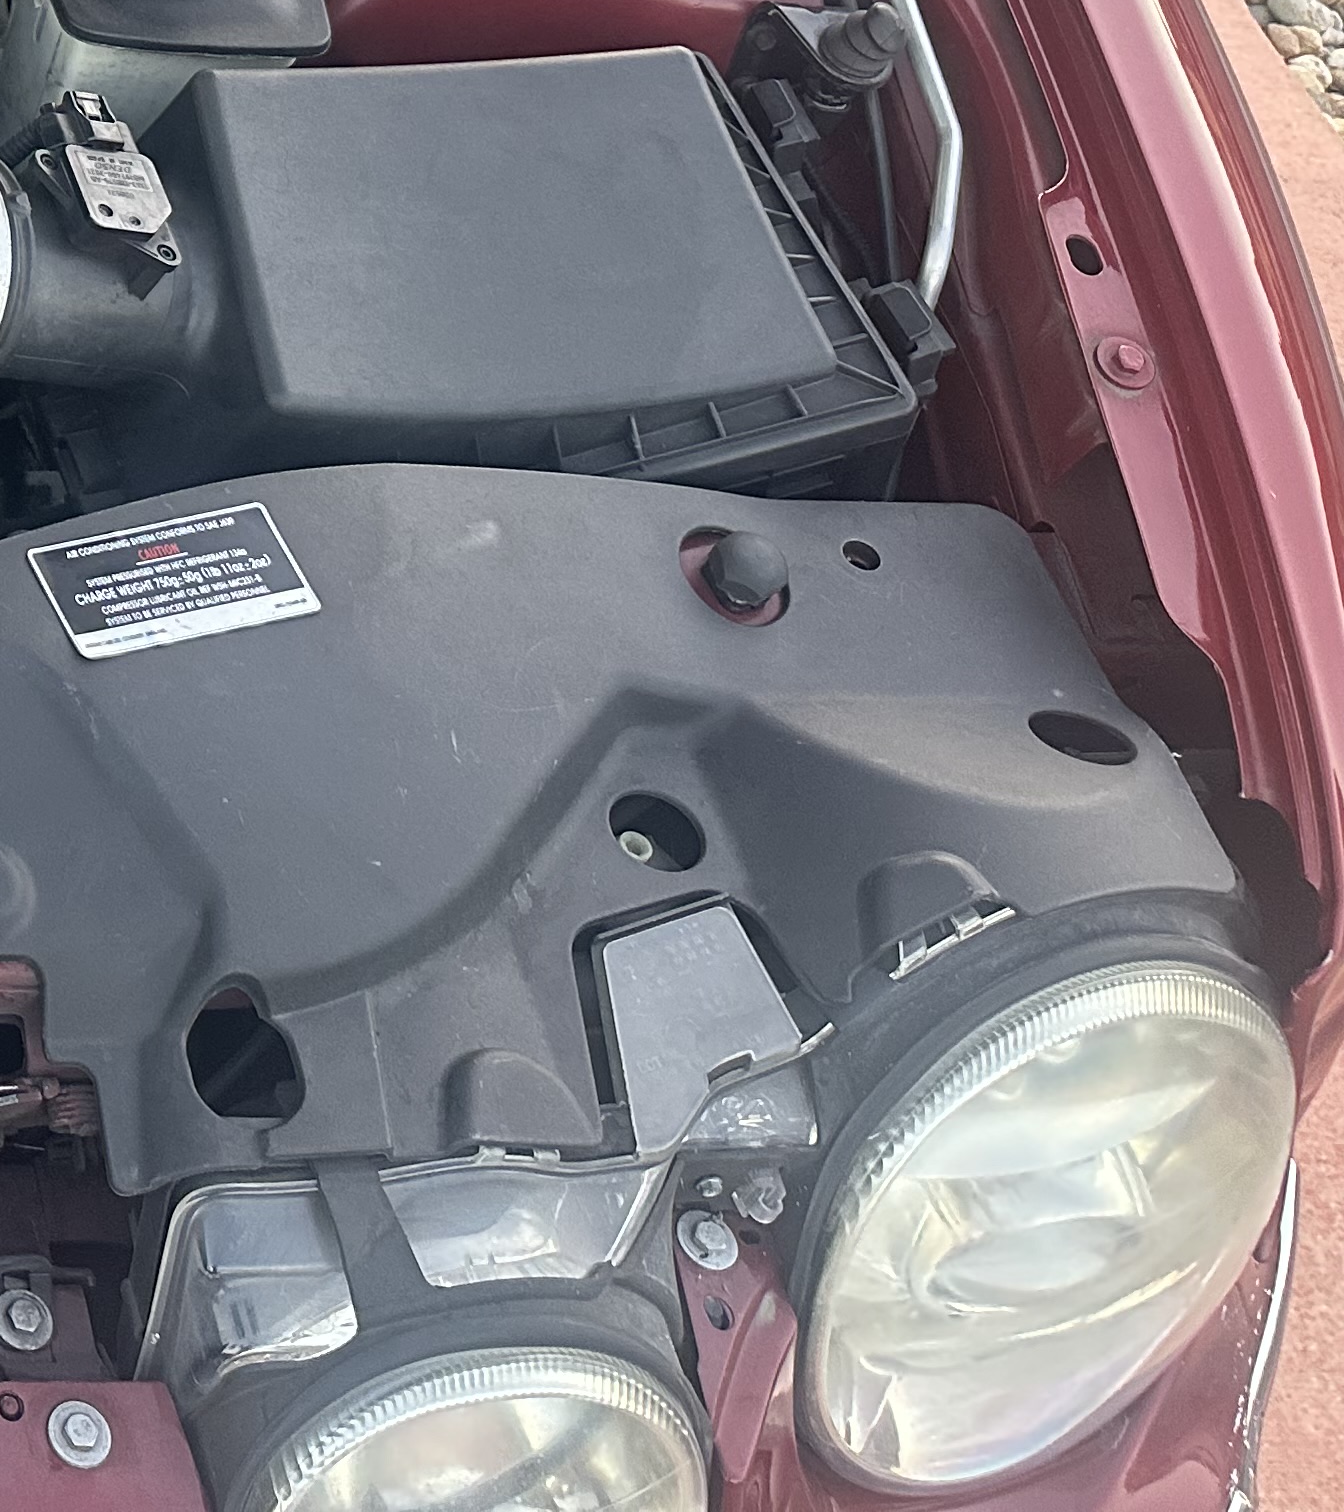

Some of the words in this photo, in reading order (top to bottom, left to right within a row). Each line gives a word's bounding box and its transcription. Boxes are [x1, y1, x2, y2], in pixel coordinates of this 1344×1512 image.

[137, 543, 181, 561] CAUTION
[74, 587, 118, 606] CHARGE
[115, 579, 155, 597] WEIGHT
